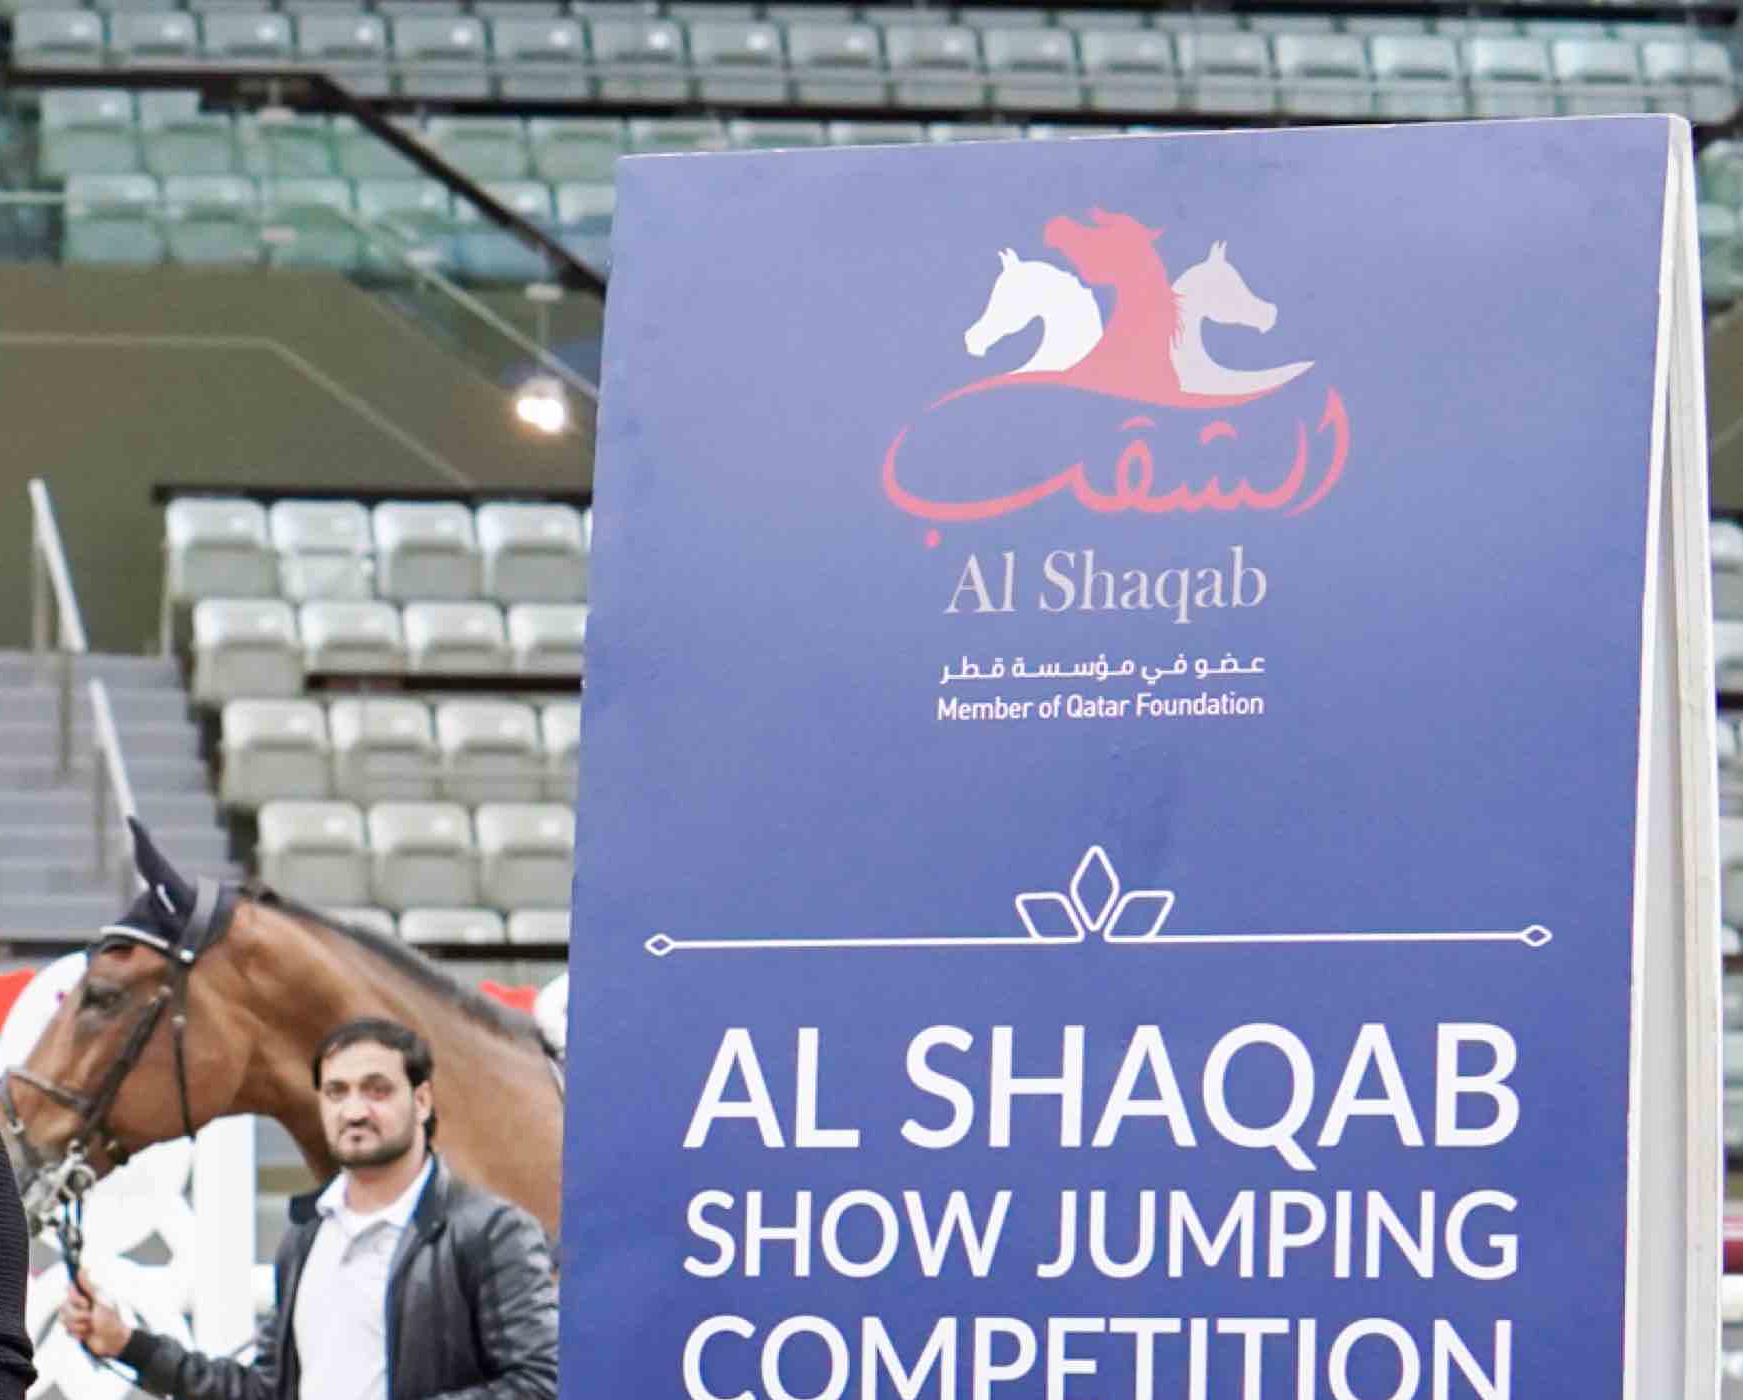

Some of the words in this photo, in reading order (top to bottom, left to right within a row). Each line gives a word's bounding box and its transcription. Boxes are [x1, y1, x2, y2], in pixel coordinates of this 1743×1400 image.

[943, 550, 1016, 614] Al
[1038, 545, 1268, 624] Shaqab
[939, 655, 1005, 685] قطر
[1010, 653, 1135, 682] مؤسسة
[1141, 652, 1188, 686] في
[1194, 651, 1265, 680] عضو
[937, 695, 1033, 721] Member
[1038, 694, 1062, 720] of
[1066, 693, 1130, 719] Qatar
[1136, 691, 1265, 718] Foundation
[683, 1027, 860, 1150] AL
[899, 1022, 1520, 1171] SHAQAB
[683, 1188, 1012, 1279] SHOW
[1037, 1188, 1518, 1281] JUMPING
